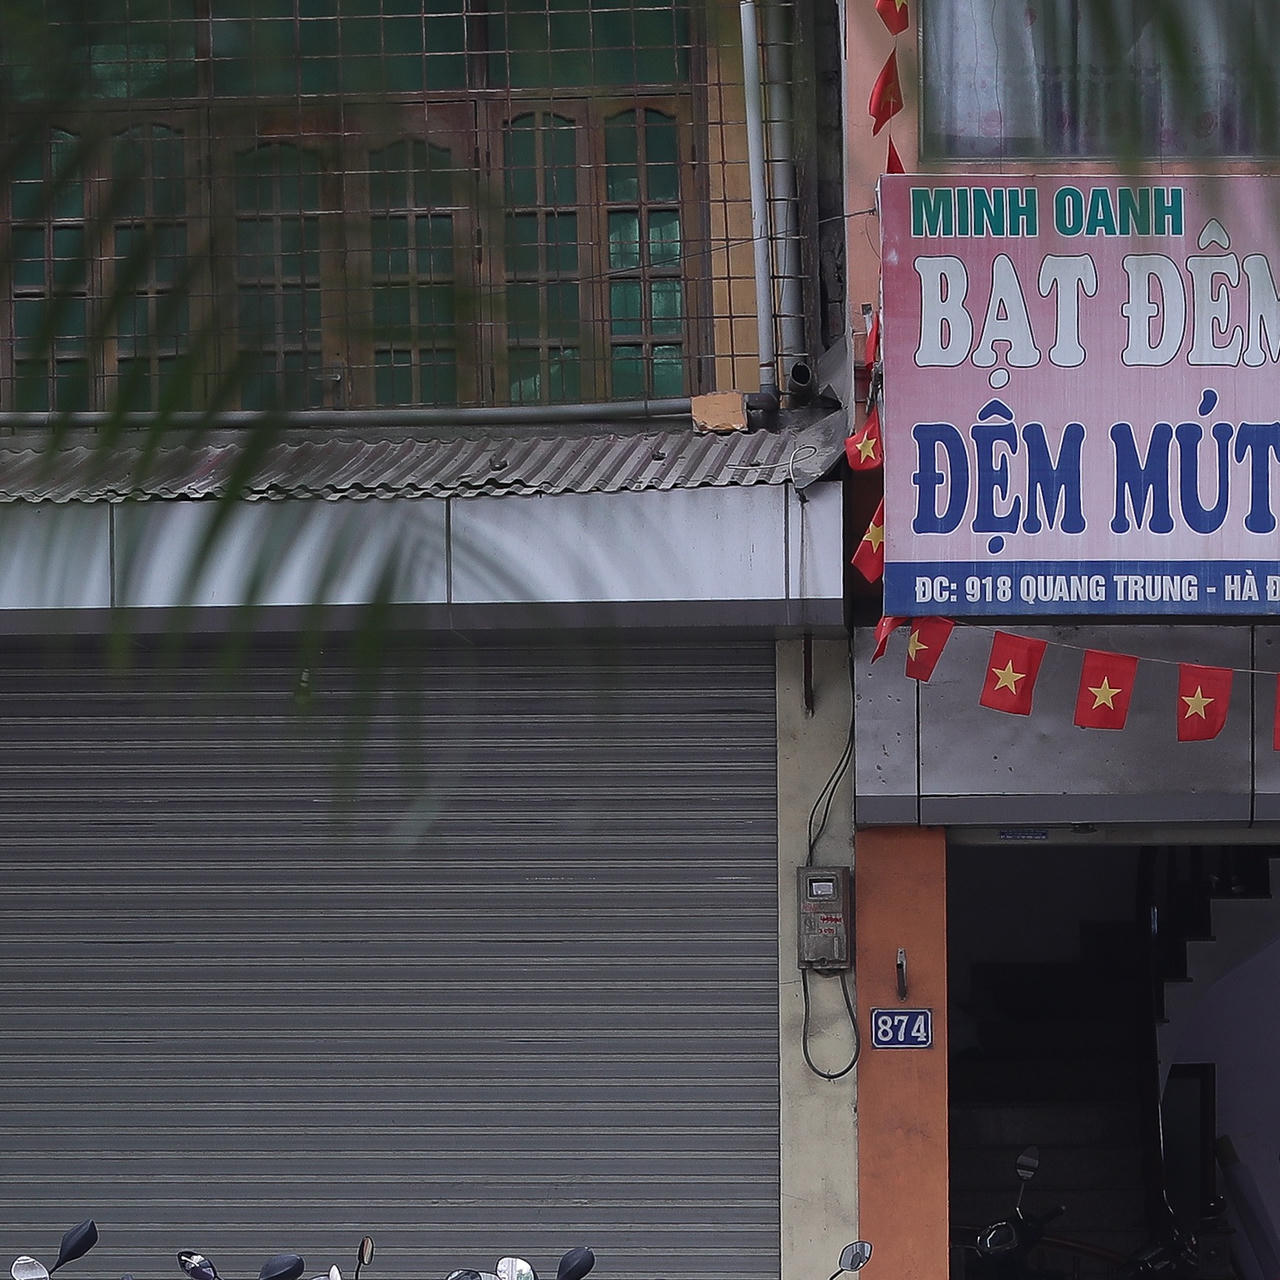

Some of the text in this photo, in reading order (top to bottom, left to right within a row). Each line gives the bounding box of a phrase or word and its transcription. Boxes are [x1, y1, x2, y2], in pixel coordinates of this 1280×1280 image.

[911, 186, 1185, 238] MINH OANH
[913, 253, 1098, 389] BẠT
[911, 398, 1087, 555] ĐỆM
[915, 577, 957, 602] ĐC:
[965, 576, 1012, 602] 918
[1019, 575, 1106, 605] QUANG
[1114, 575, 1199, 602] TRUNG
[1224, 569, 1259, 601] HÀ
[876, 1014, 928, 1043] 874
